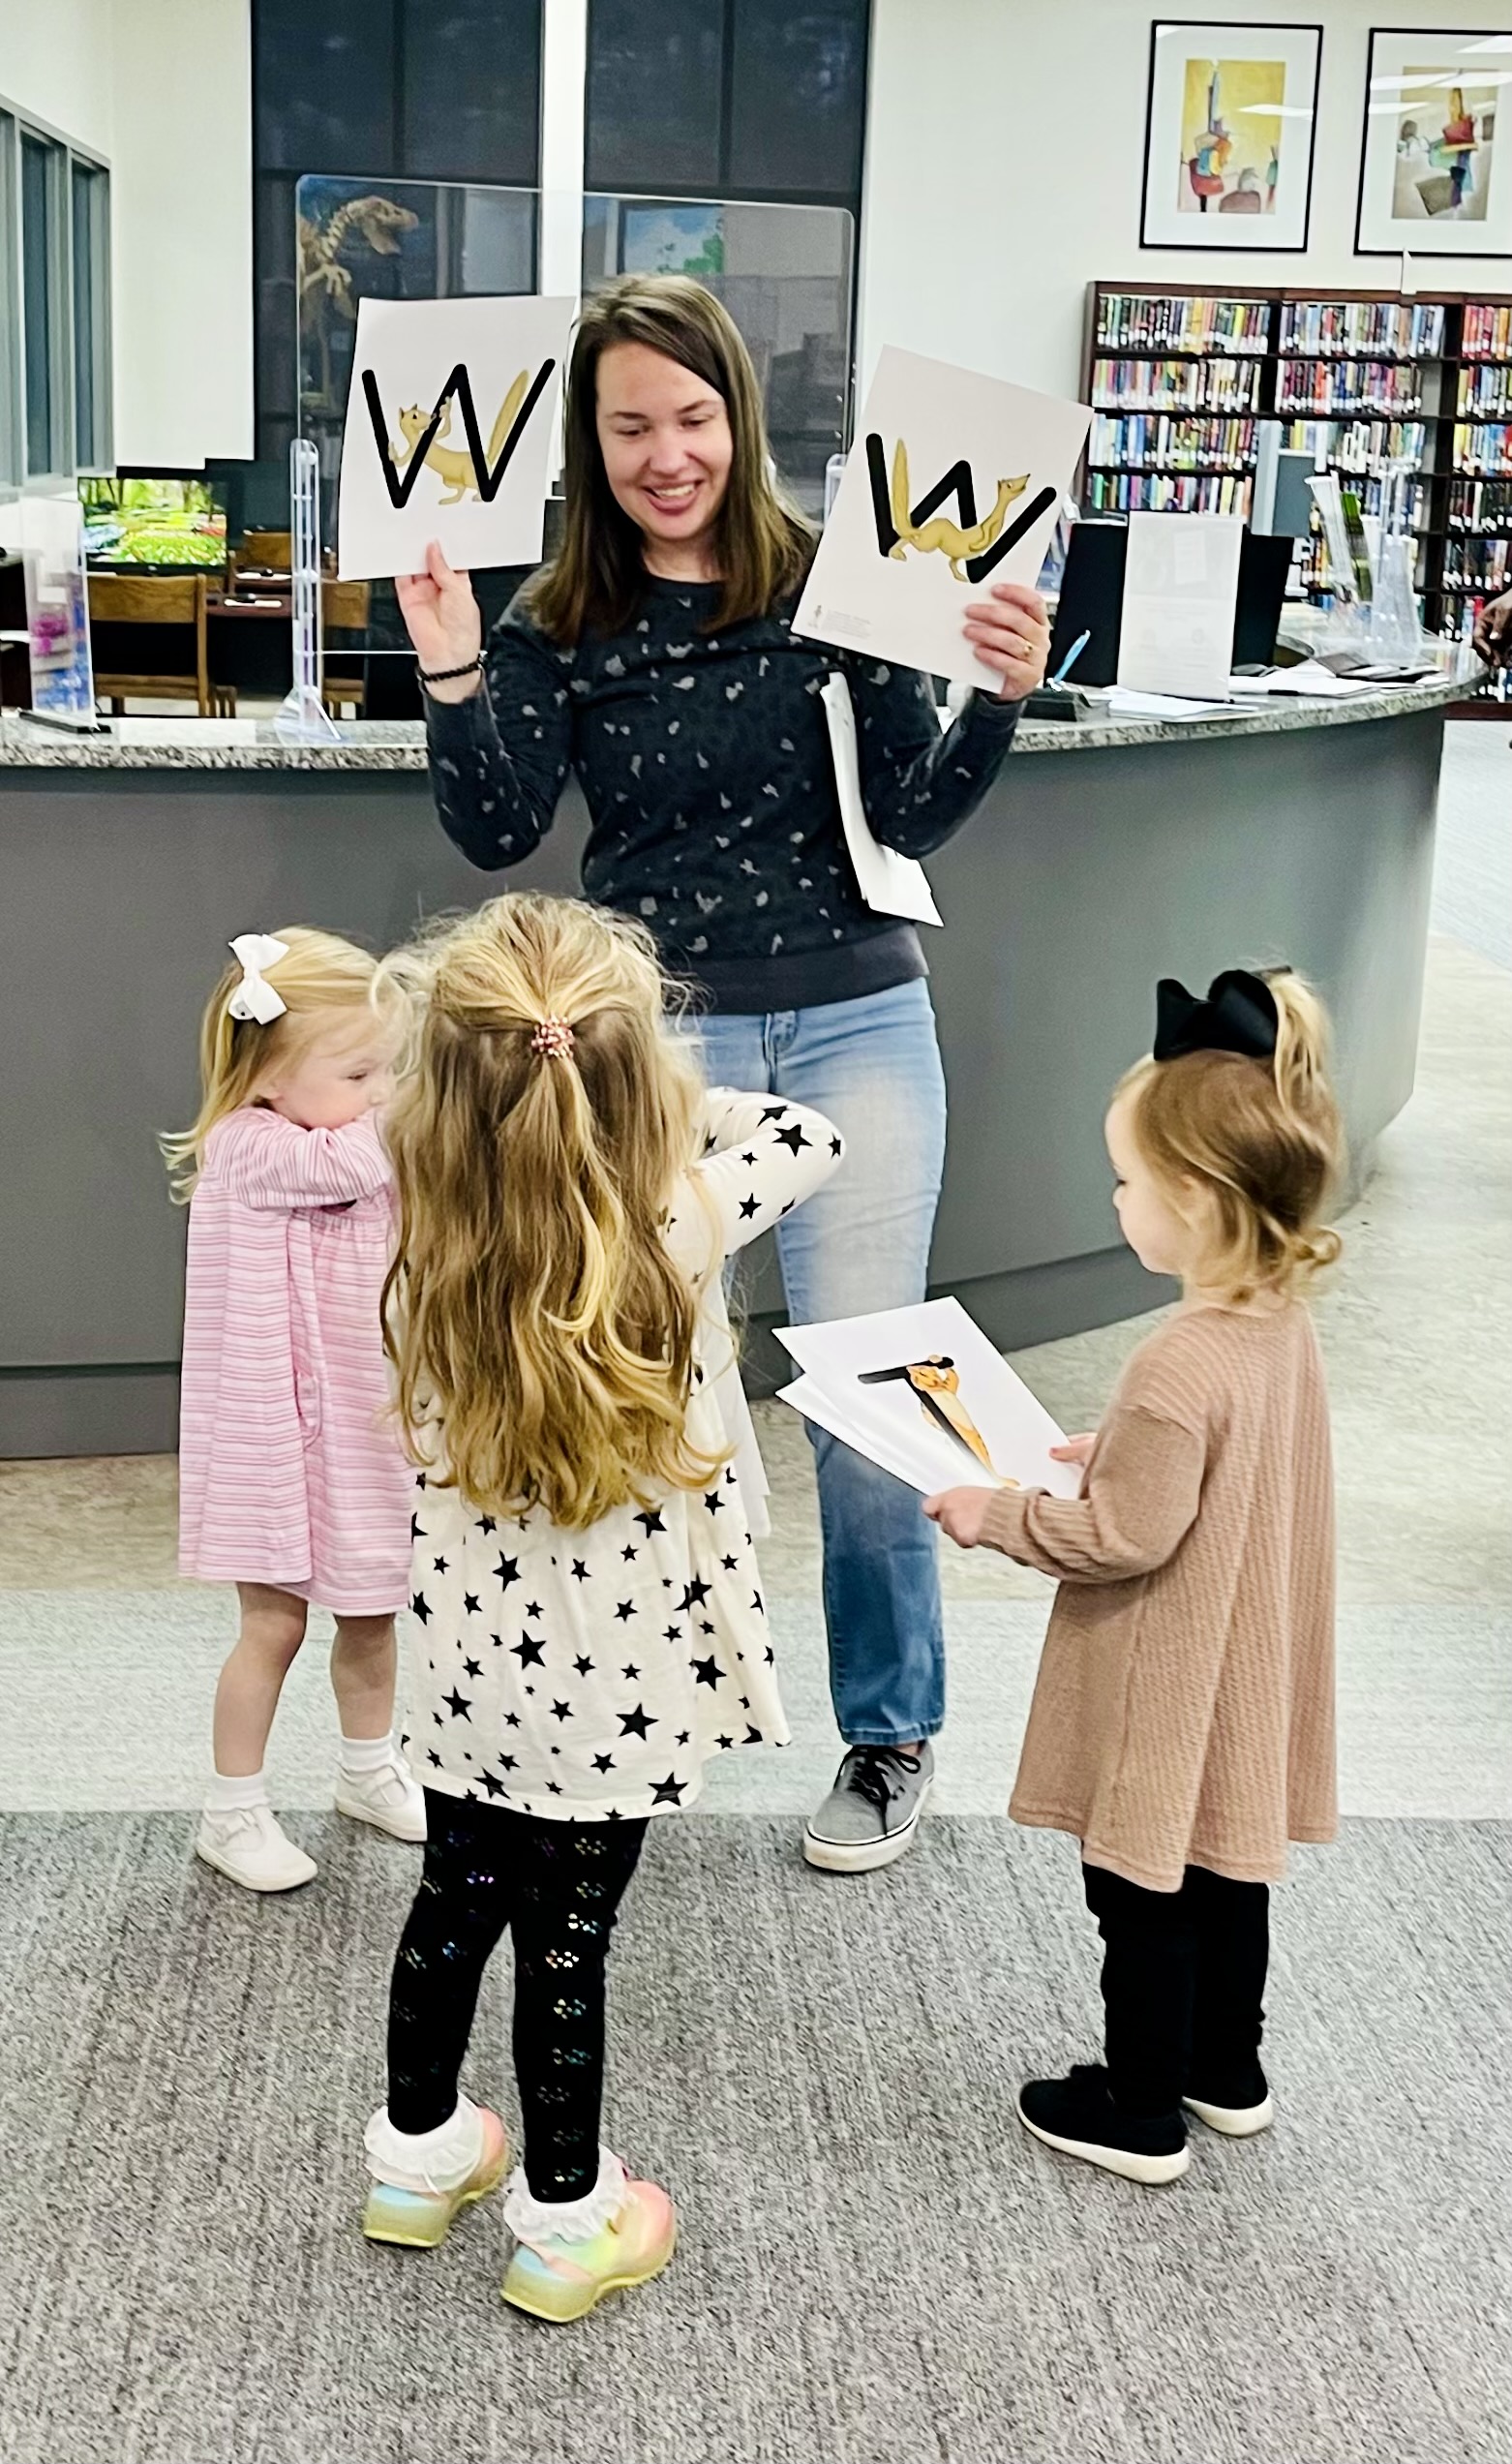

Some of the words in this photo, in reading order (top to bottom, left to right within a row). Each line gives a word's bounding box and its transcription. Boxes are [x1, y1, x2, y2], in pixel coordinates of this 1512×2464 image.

[362, 358, 556, 509] W
[865, 433, 1057, 584] W
[858, 1355, 989, 1475] T
